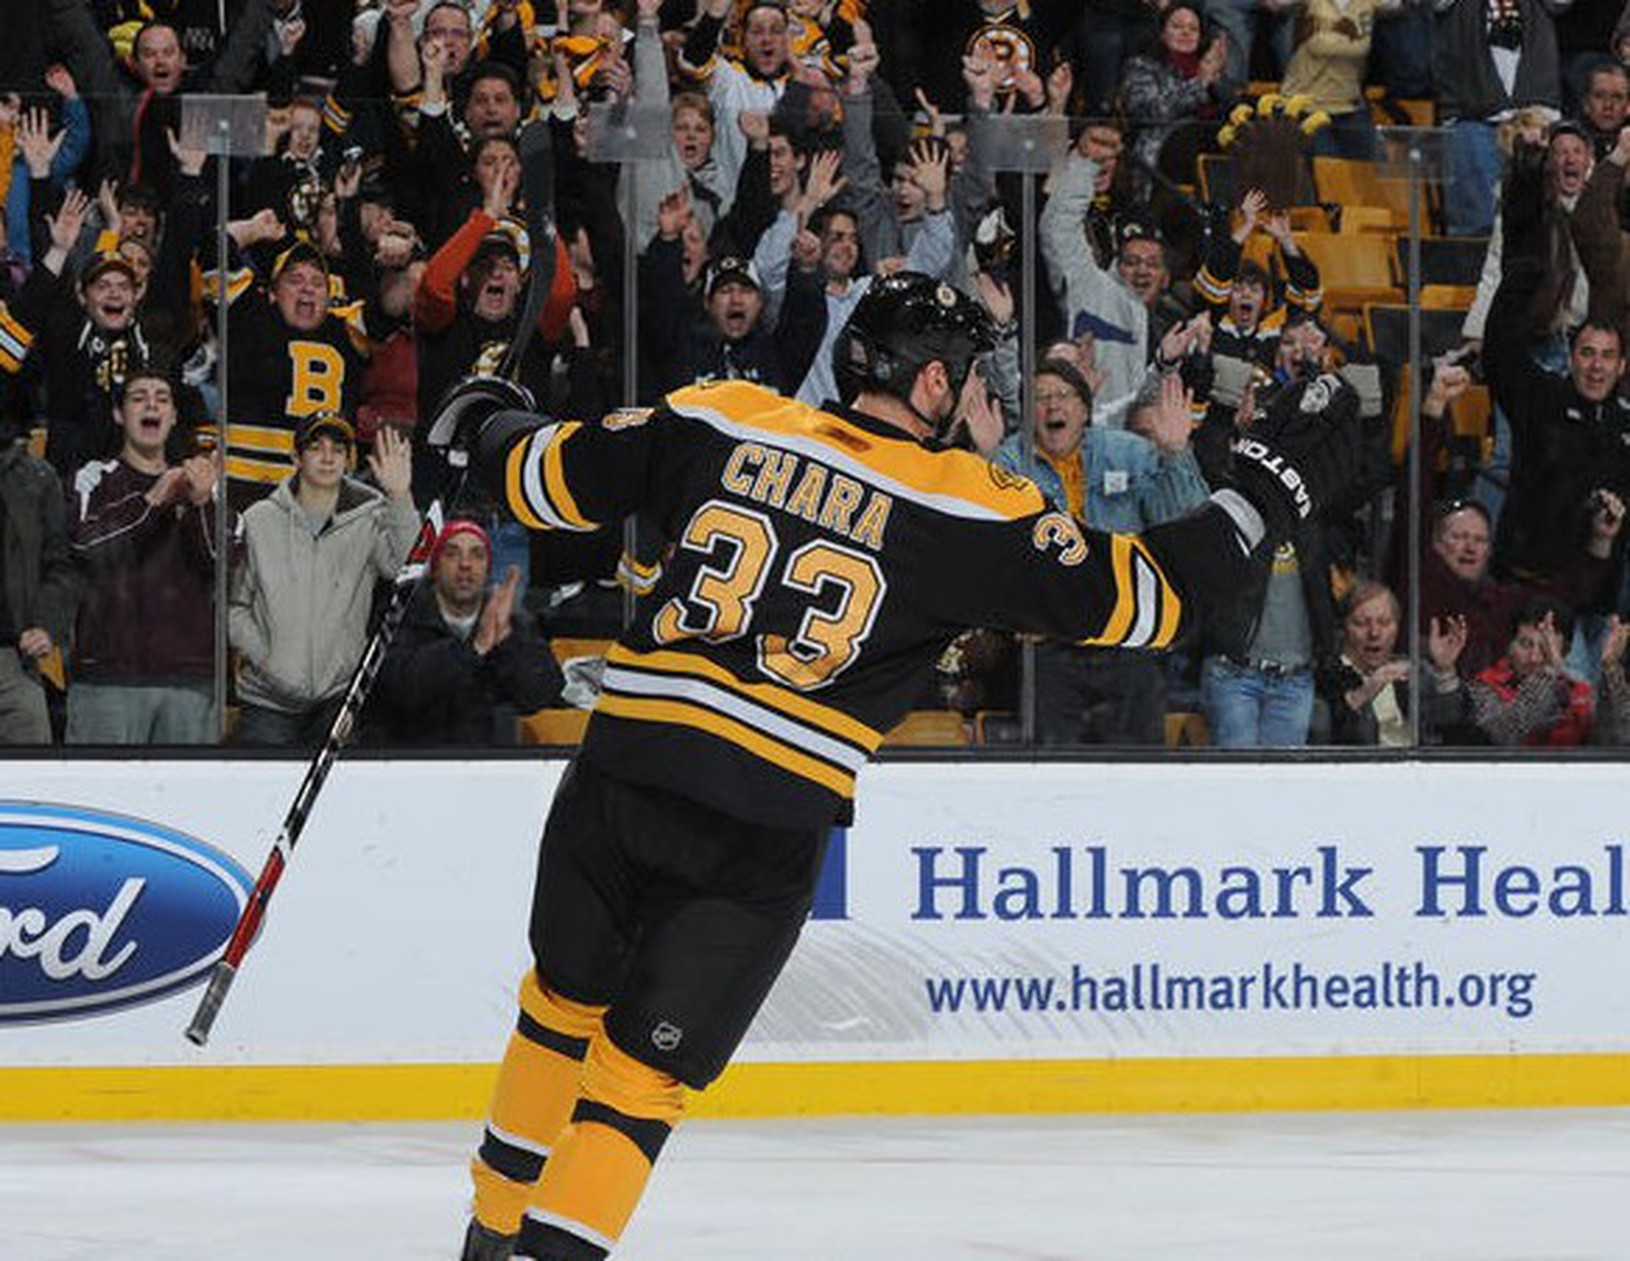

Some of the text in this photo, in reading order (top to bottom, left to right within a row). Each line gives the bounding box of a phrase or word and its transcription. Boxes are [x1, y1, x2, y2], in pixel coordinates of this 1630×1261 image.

[285, 341, 345, 417] B
[721, 442, 893, 550] CHARA
[653, 499, 887, 692] 33
[911, 845, 1628, 920] Hallmark Heal
[926, 961, 1537, 1018] www.hallmarkhealth.org
